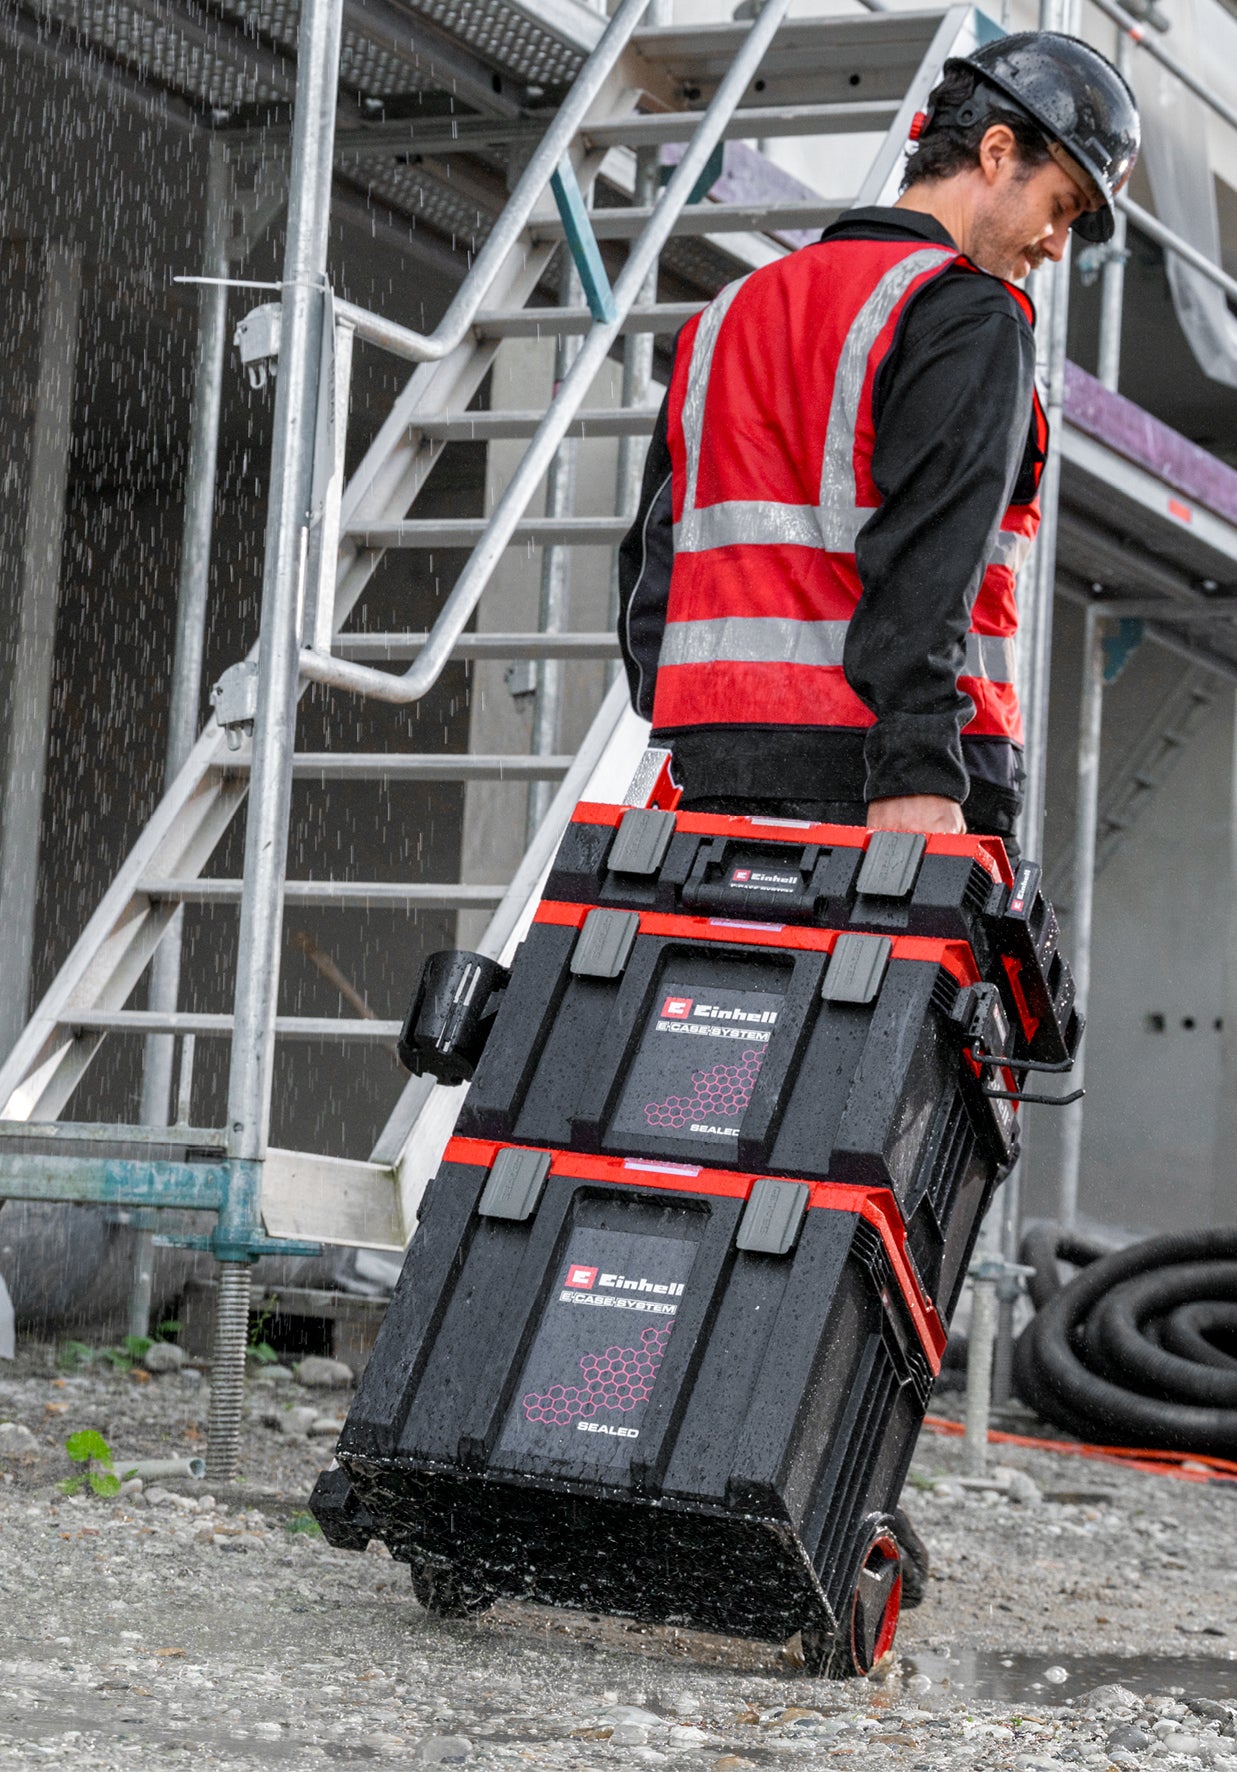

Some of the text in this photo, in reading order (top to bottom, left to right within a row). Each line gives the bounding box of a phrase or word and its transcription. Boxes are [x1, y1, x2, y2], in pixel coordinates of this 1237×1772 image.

[751, 872, 798, 885] Einhell
[693, 1004, 778, 1024] Einhell
[598, 1273, 685, 1296] Einhell
[577, 1421, 640, 1439] SEALED
